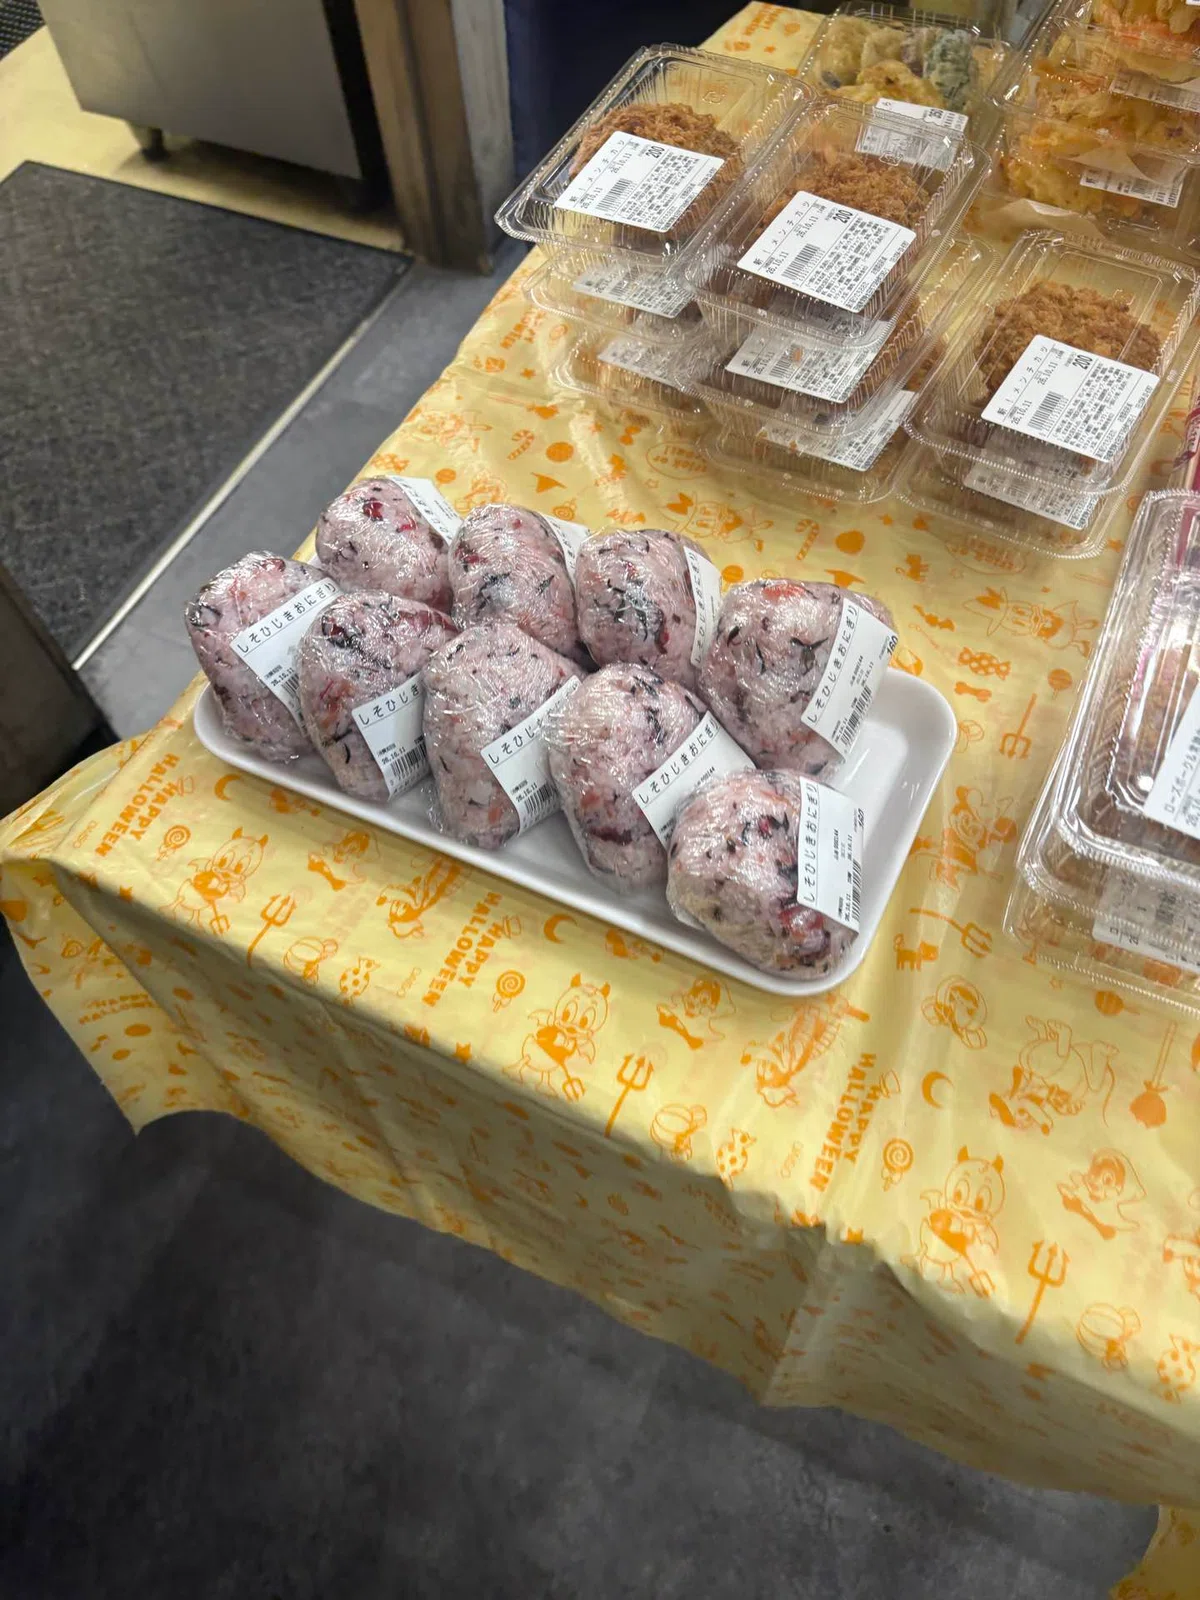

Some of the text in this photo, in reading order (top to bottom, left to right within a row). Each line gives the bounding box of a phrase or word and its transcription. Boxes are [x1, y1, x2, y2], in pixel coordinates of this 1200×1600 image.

[643, 144, 666, 159] 200
[831, 208, 854, 224] 200
[1070, 353, 1094, 370] 200
[236, 581, 337, 656] しそひじきおにぎり
[806, 604, 858, 723] しそひじきおにぎり
[637, 718, 721, 805] しそひじきおにぎり
[95, 753, 181, 857] HALLOWEEN
[129, 782, 178, 841] HAPPY
[803, 783, 819, 902] しそひじきおにぎり
[421, 891, 504, 1008] HALLOWEEN
[458, 922, 503, 988] HAPPY
[809, 1053, 877, 1193] HALLOWEEN
[843, 1085, 881, 1166] HAPPY
